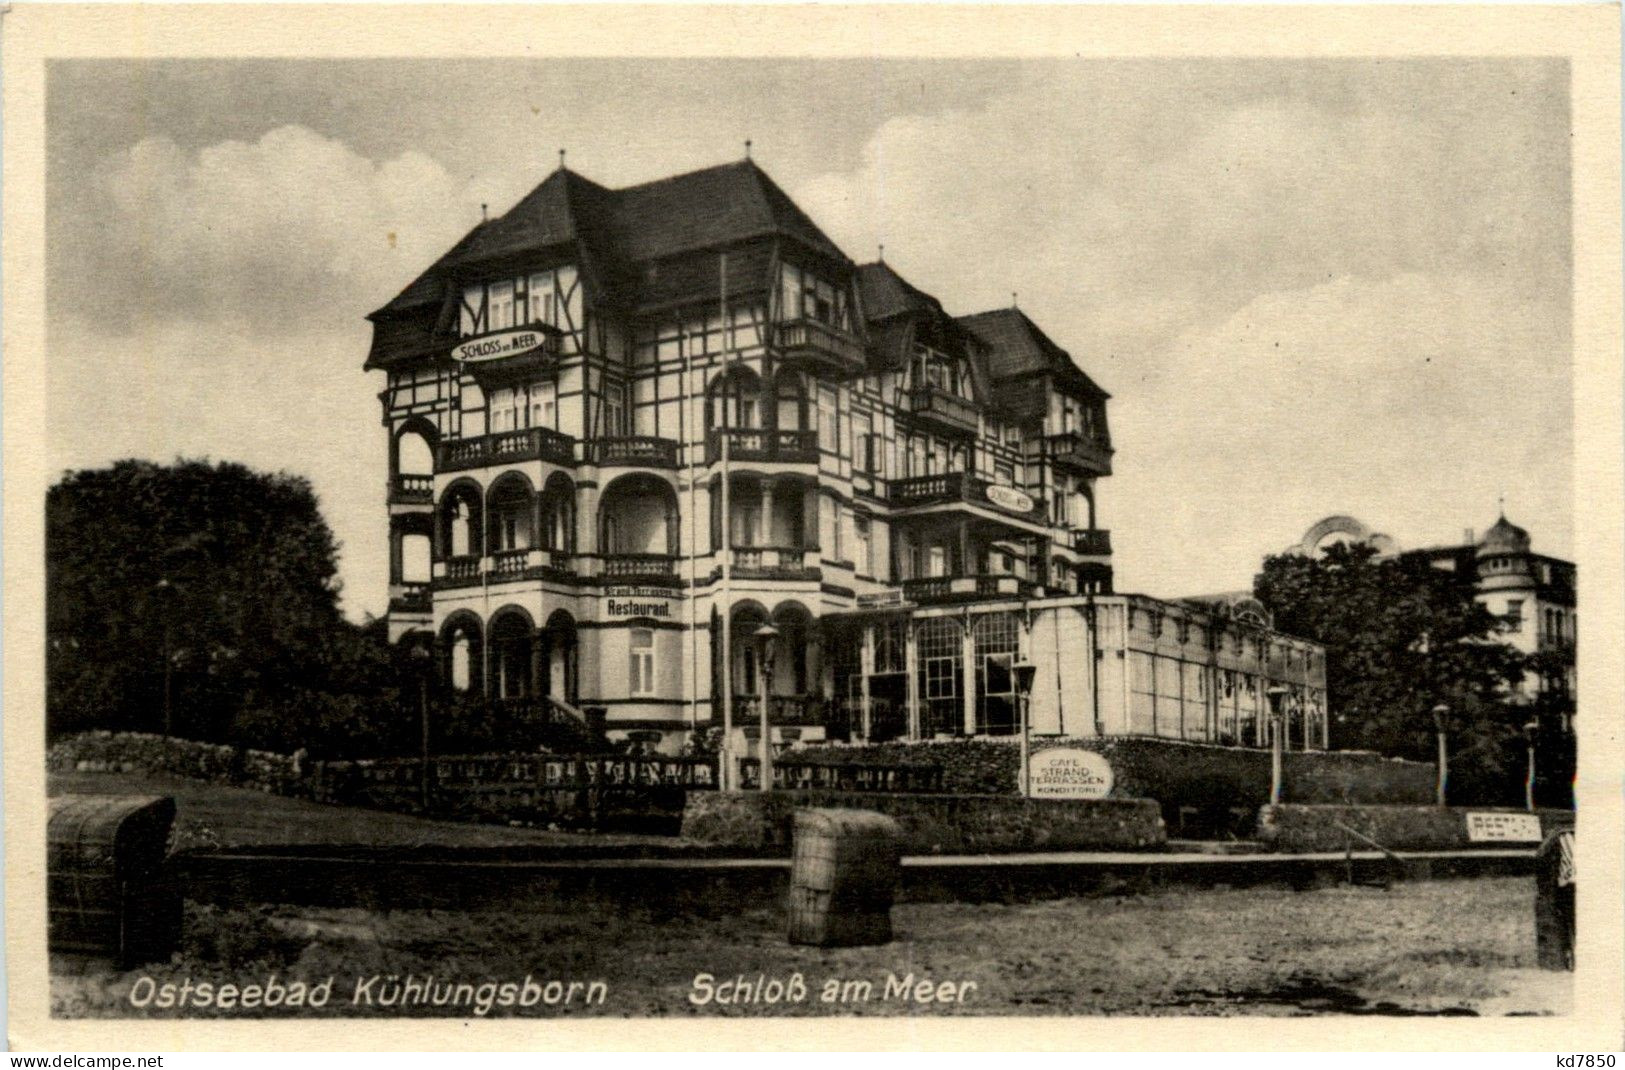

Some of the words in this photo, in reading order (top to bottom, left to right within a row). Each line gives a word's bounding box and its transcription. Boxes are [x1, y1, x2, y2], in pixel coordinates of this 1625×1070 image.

[460, 340, 502, 359] SCHLOSS
[512, 334, 537, 349] MEER
[1030, 776, 1104, 785] TERRASSEN
